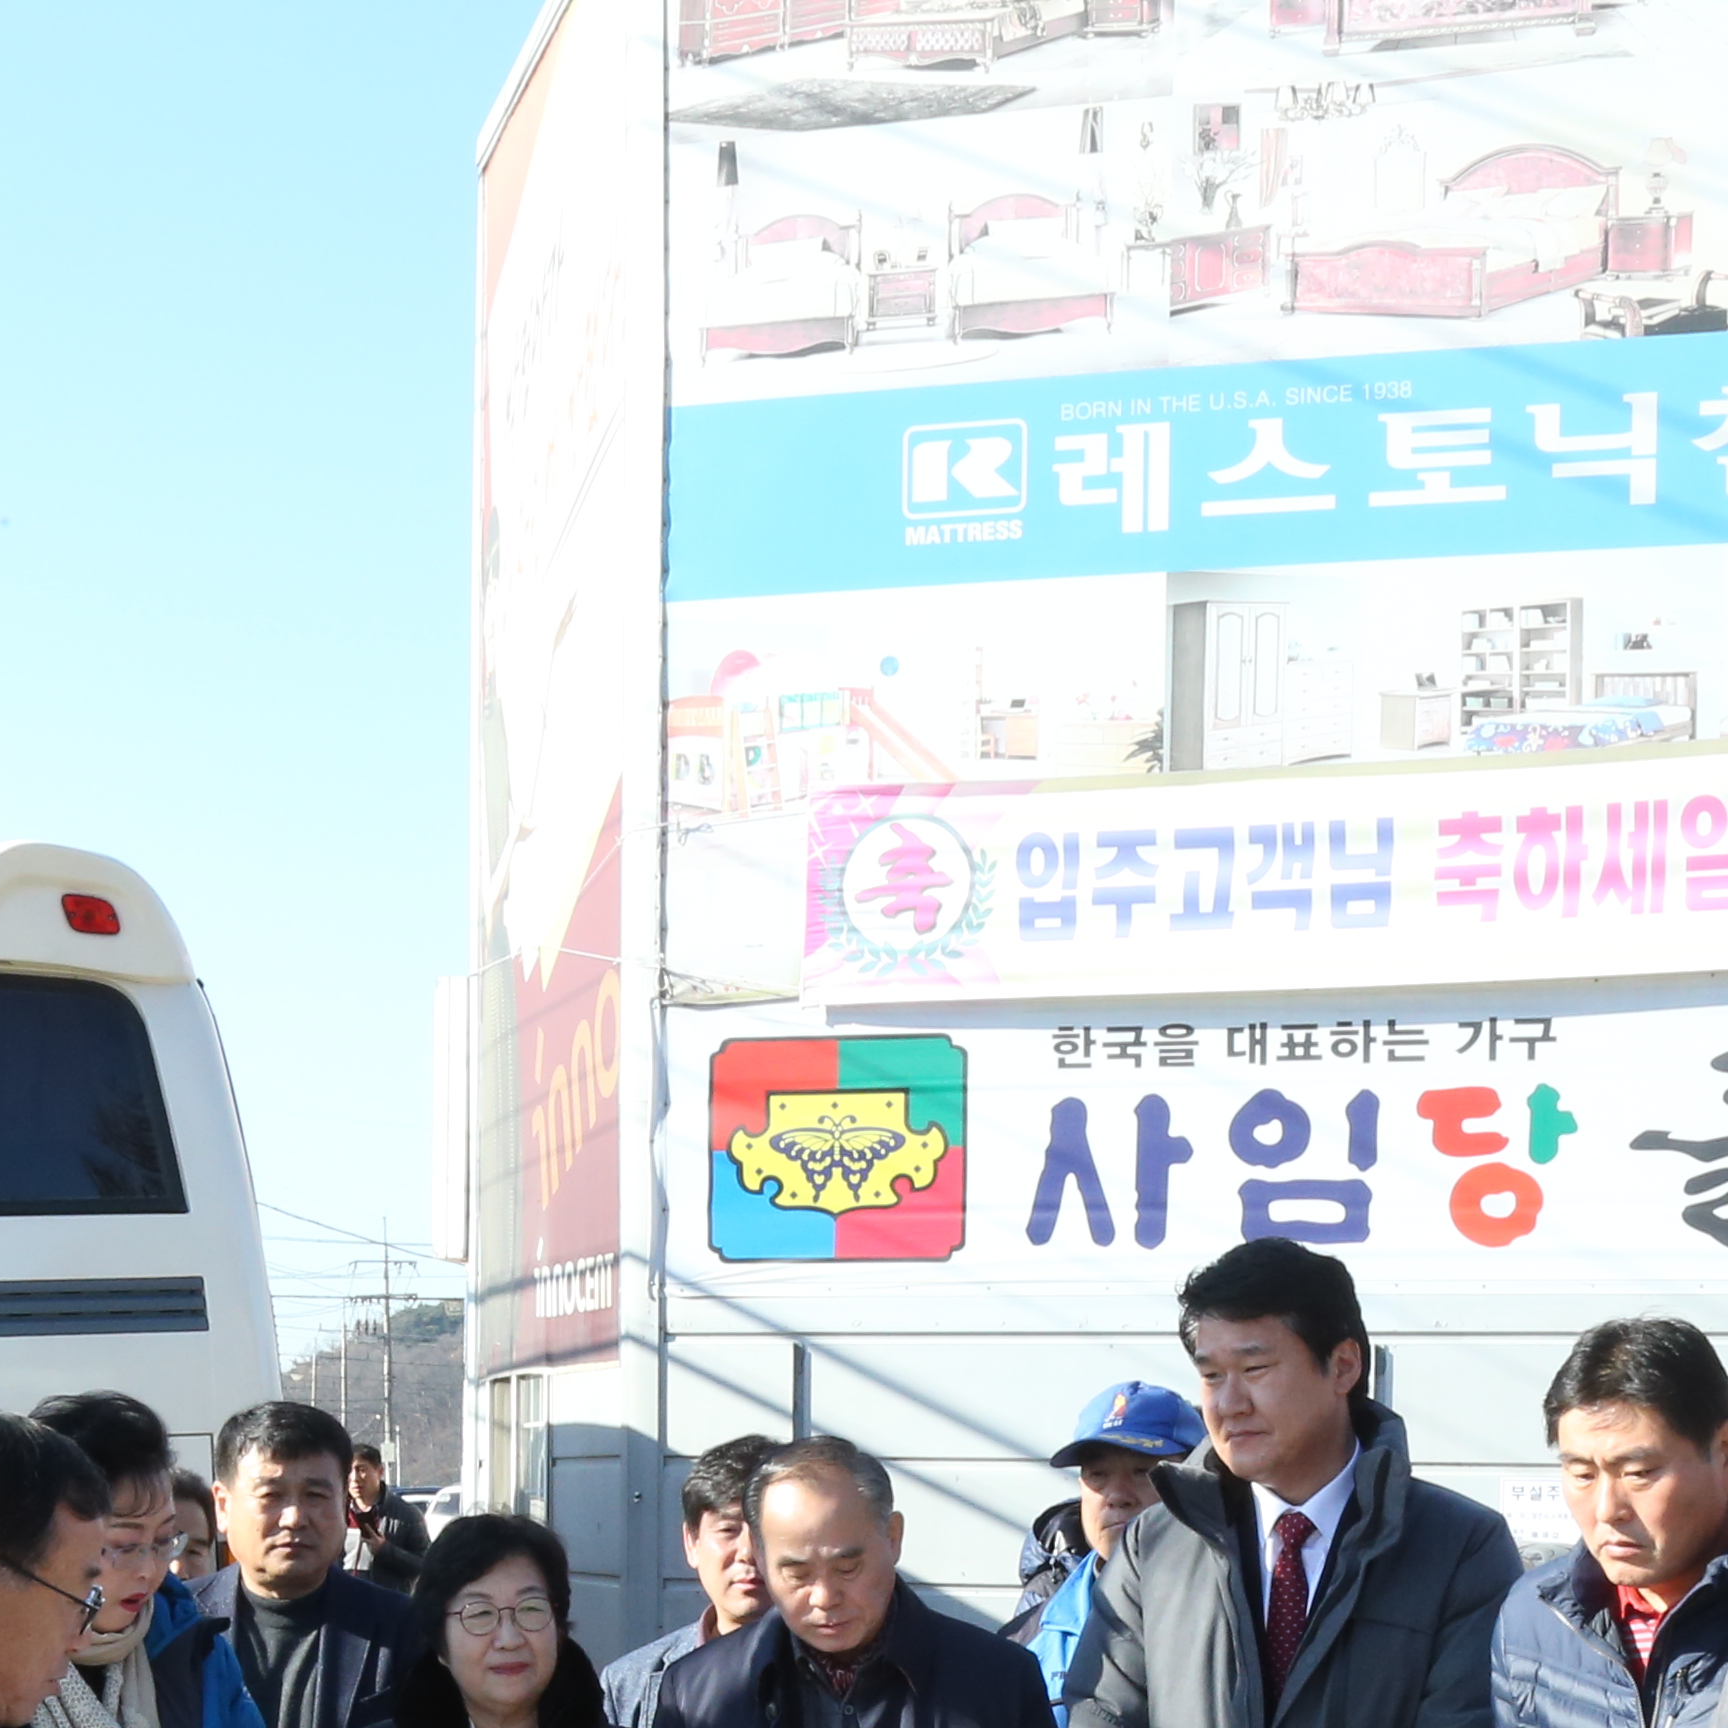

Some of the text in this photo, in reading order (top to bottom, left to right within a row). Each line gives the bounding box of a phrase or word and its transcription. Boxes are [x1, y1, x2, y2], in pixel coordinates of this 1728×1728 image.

[1060, 380, 1413, 421] BORN IN THE U.S.A. SINCE 1938
[904, 518, 1023, 546] MATTRESS
[1015, 817, 1394, 942] 입주고객님
[1052, 1017, 1558, 1069] 한국을 대표하는 가구
[1025, 1083, 1579, 1250] 사임당
